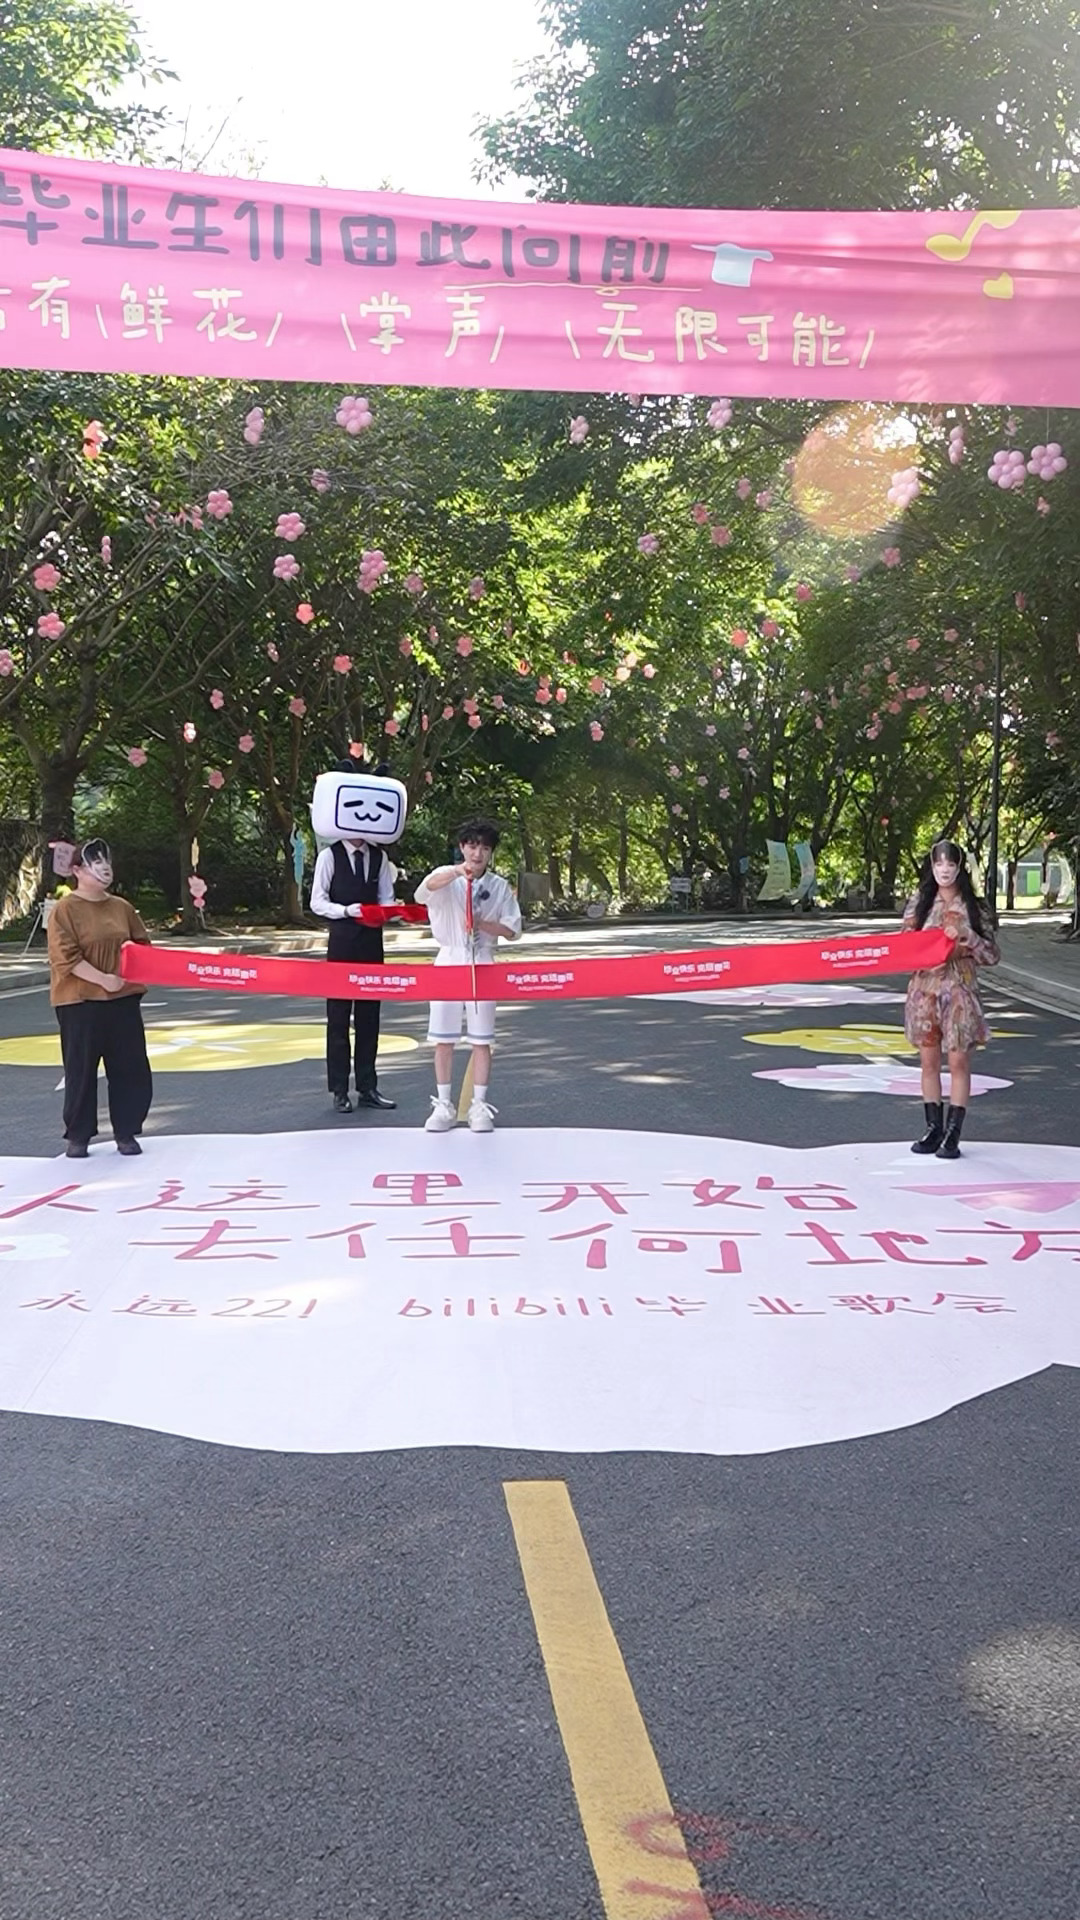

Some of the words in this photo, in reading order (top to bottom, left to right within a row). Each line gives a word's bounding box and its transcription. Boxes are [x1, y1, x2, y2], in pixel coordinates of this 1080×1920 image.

[0, 171, 670, 284] 毕业生们由此向前
